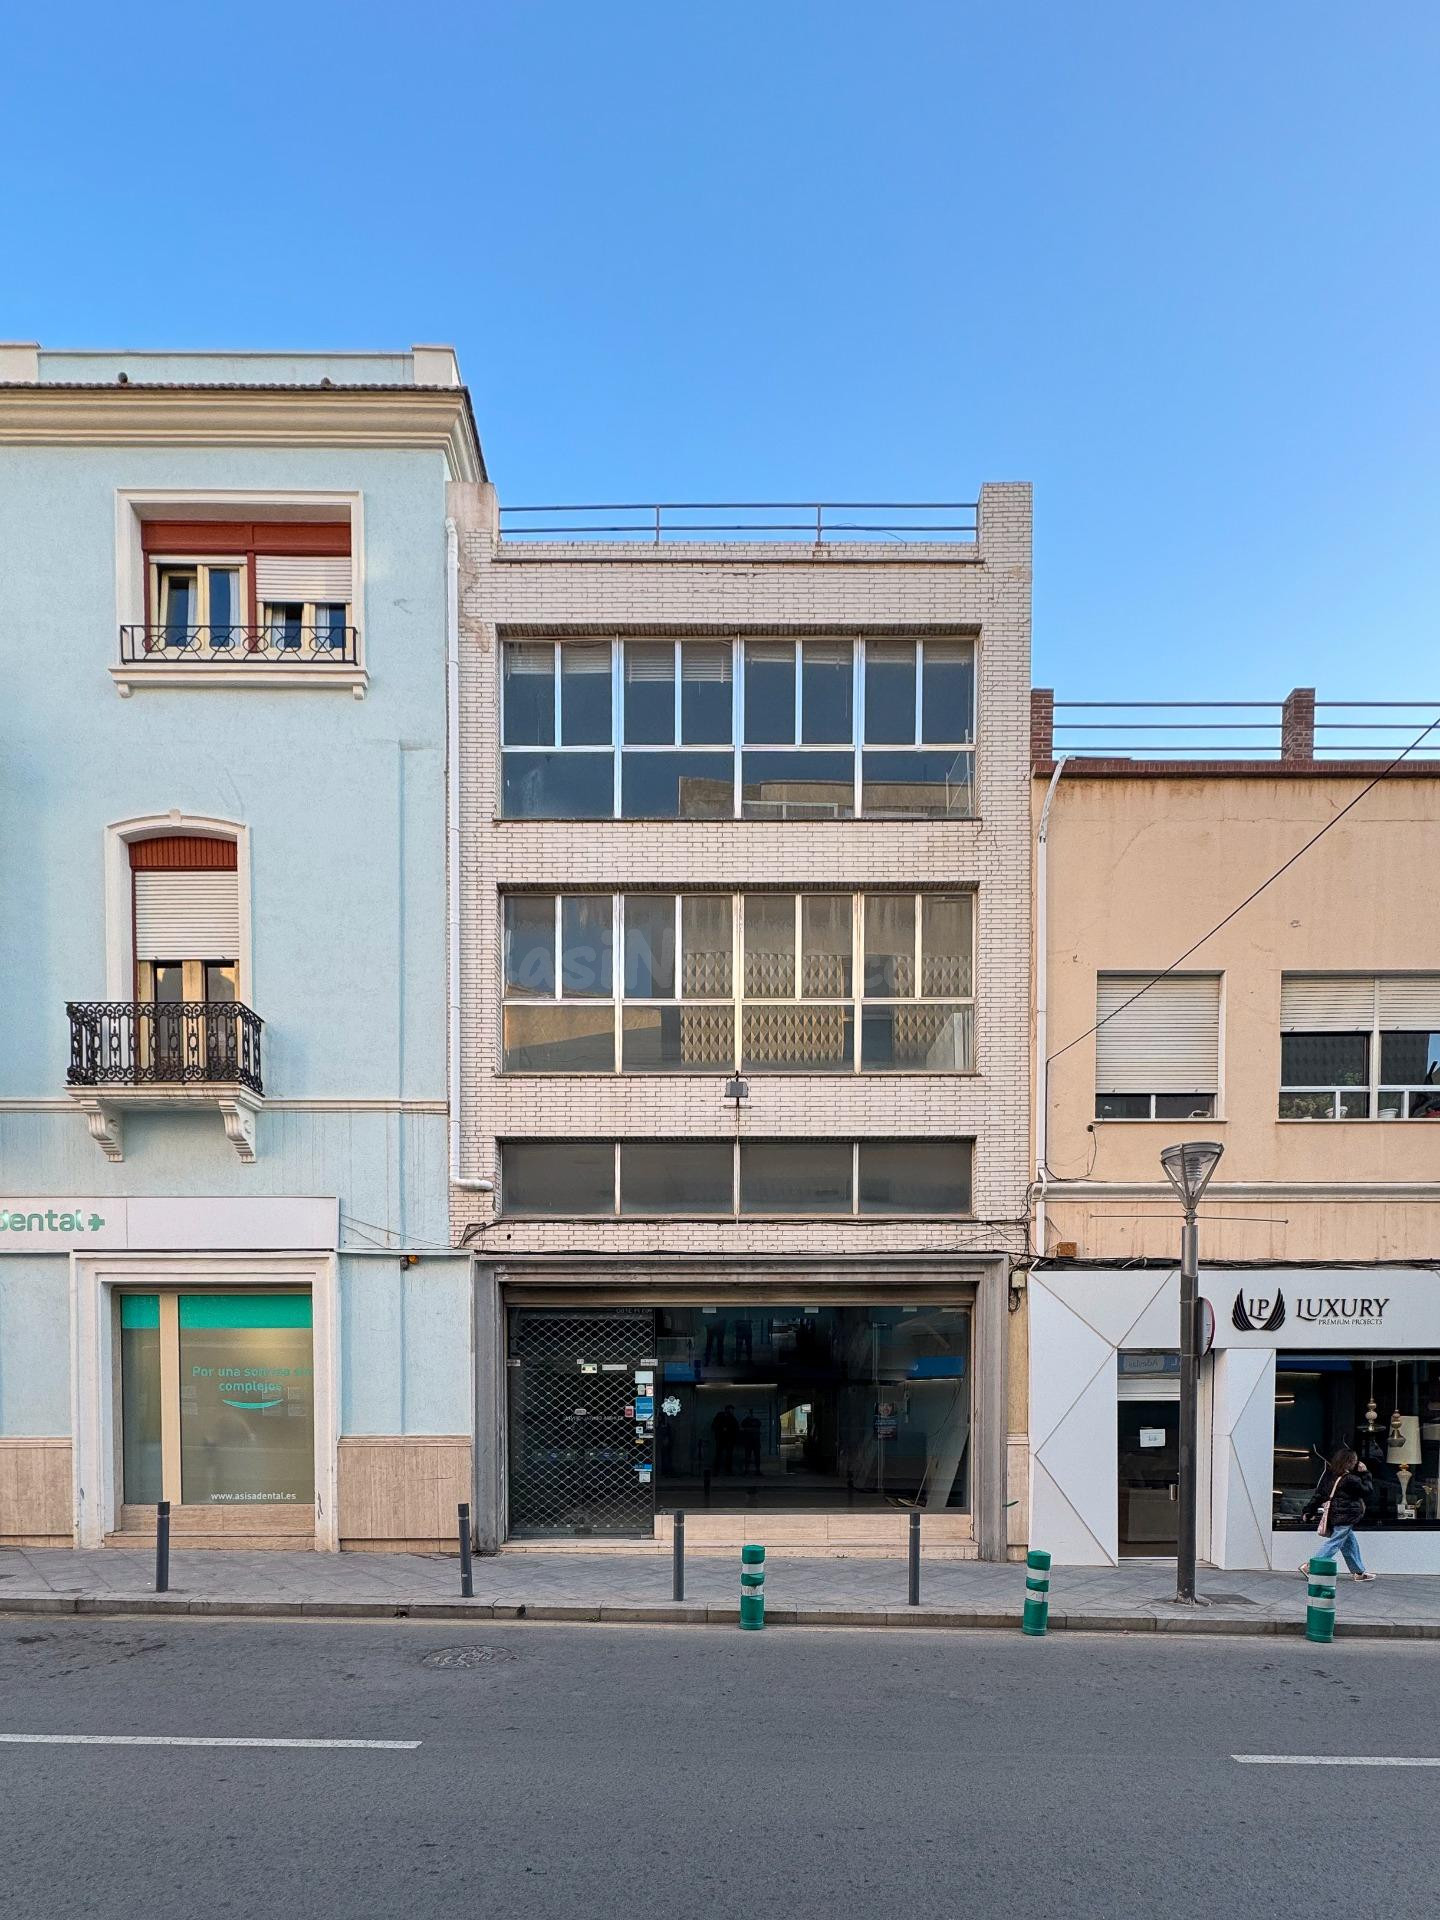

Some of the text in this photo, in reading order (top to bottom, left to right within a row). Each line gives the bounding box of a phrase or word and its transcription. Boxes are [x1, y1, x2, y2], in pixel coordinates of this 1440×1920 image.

[1248, 1299, 1270, 1321] LP
[1296, 1298, 1390, 1321] LUXURY
[192, 1366, 214, 1377] Por
[218, 1368, 241, 1377] una
[210, 1491, 297, 1501] www.asisadental.es
